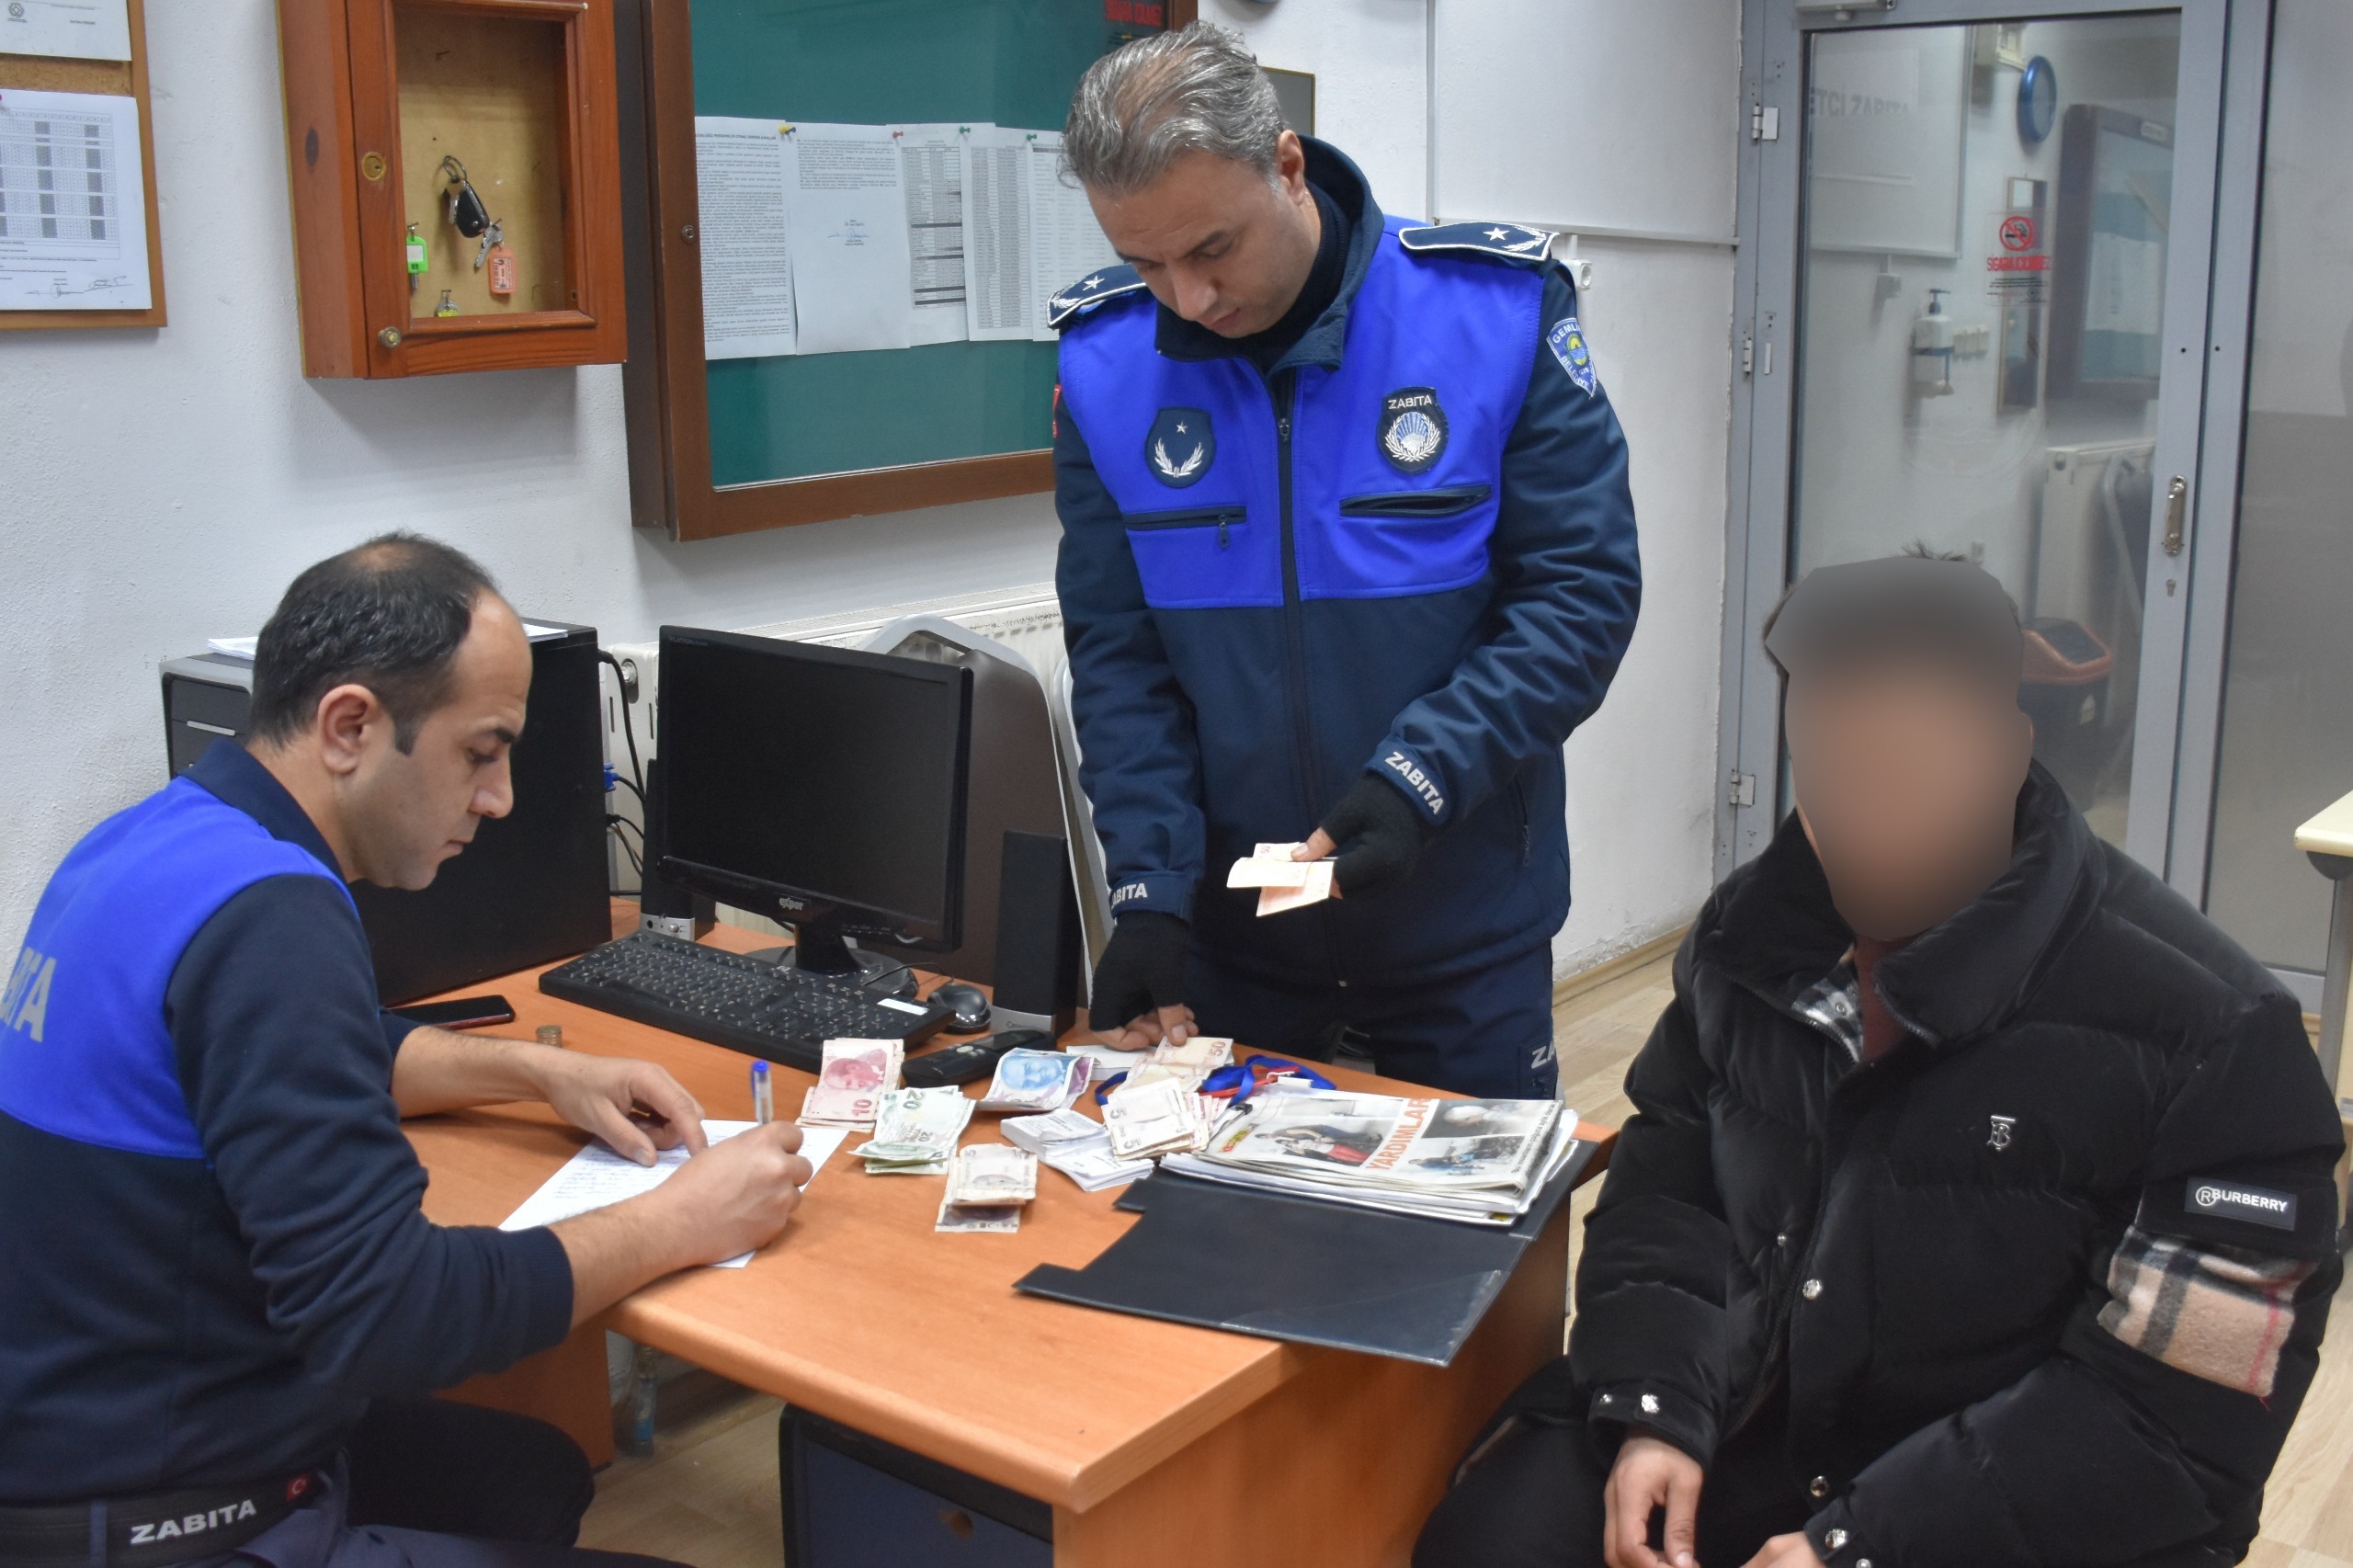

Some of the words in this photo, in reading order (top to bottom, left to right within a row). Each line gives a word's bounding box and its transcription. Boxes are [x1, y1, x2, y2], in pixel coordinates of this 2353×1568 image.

[1388, 395, 1433, 410] ZABITA
[1384, 751, 1444, 814] ZABITA
[851, 1098, 872, 1117] 10
[2211, 1187, 2288, 1212] BURBERRY
[130, 1499, 257, 1544] ZABITA
